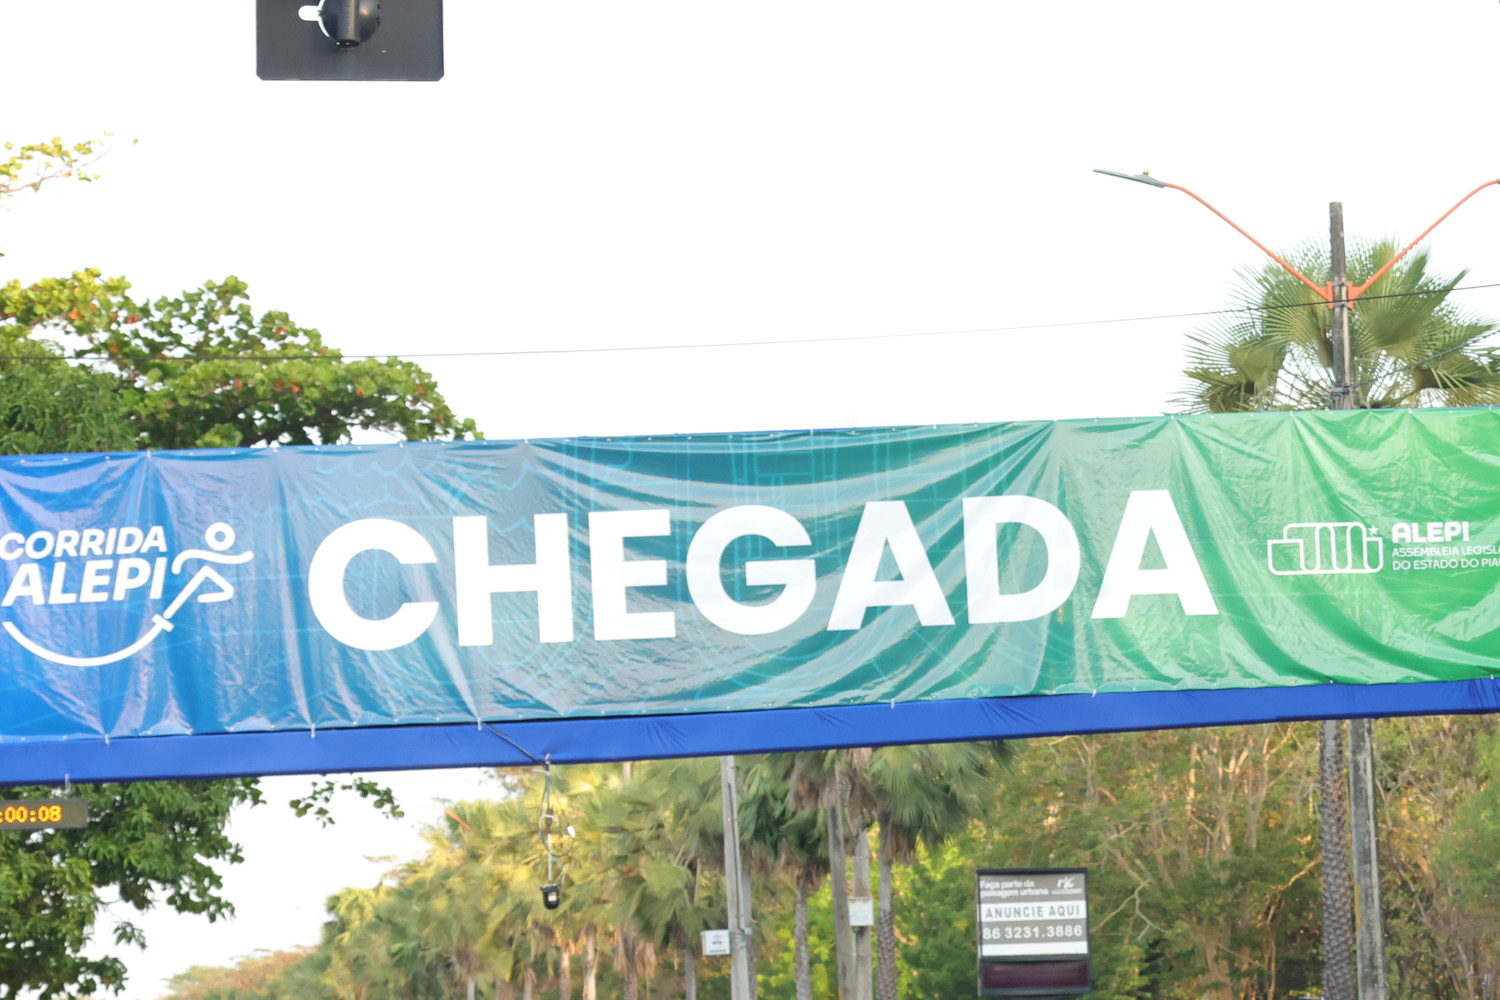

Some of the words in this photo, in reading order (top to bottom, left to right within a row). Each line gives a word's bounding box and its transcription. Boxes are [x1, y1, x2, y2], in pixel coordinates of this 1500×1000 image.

[1392, 521, 1470, 543] ALEPI
[0, 525, 168, 561] CORRIDA
[1392, 546, 1460, 557] ASSEMBLEIA
[308, 489, 1219, 651] CHEGADA
[1392, 560, 1411, 570] DO
[1413, 559, 1459, 569] ESTADO
[1461, 558, 1479, 568] DO
[0, 557, 168, 607] ALEPI
[985, 905, 1044, 918] ANUNCIE
[1048, 905, 1080, 917] AQUI
[982, 927, 1001, 939] 86
[1004, 925, 1082, 938] 3231.3886
